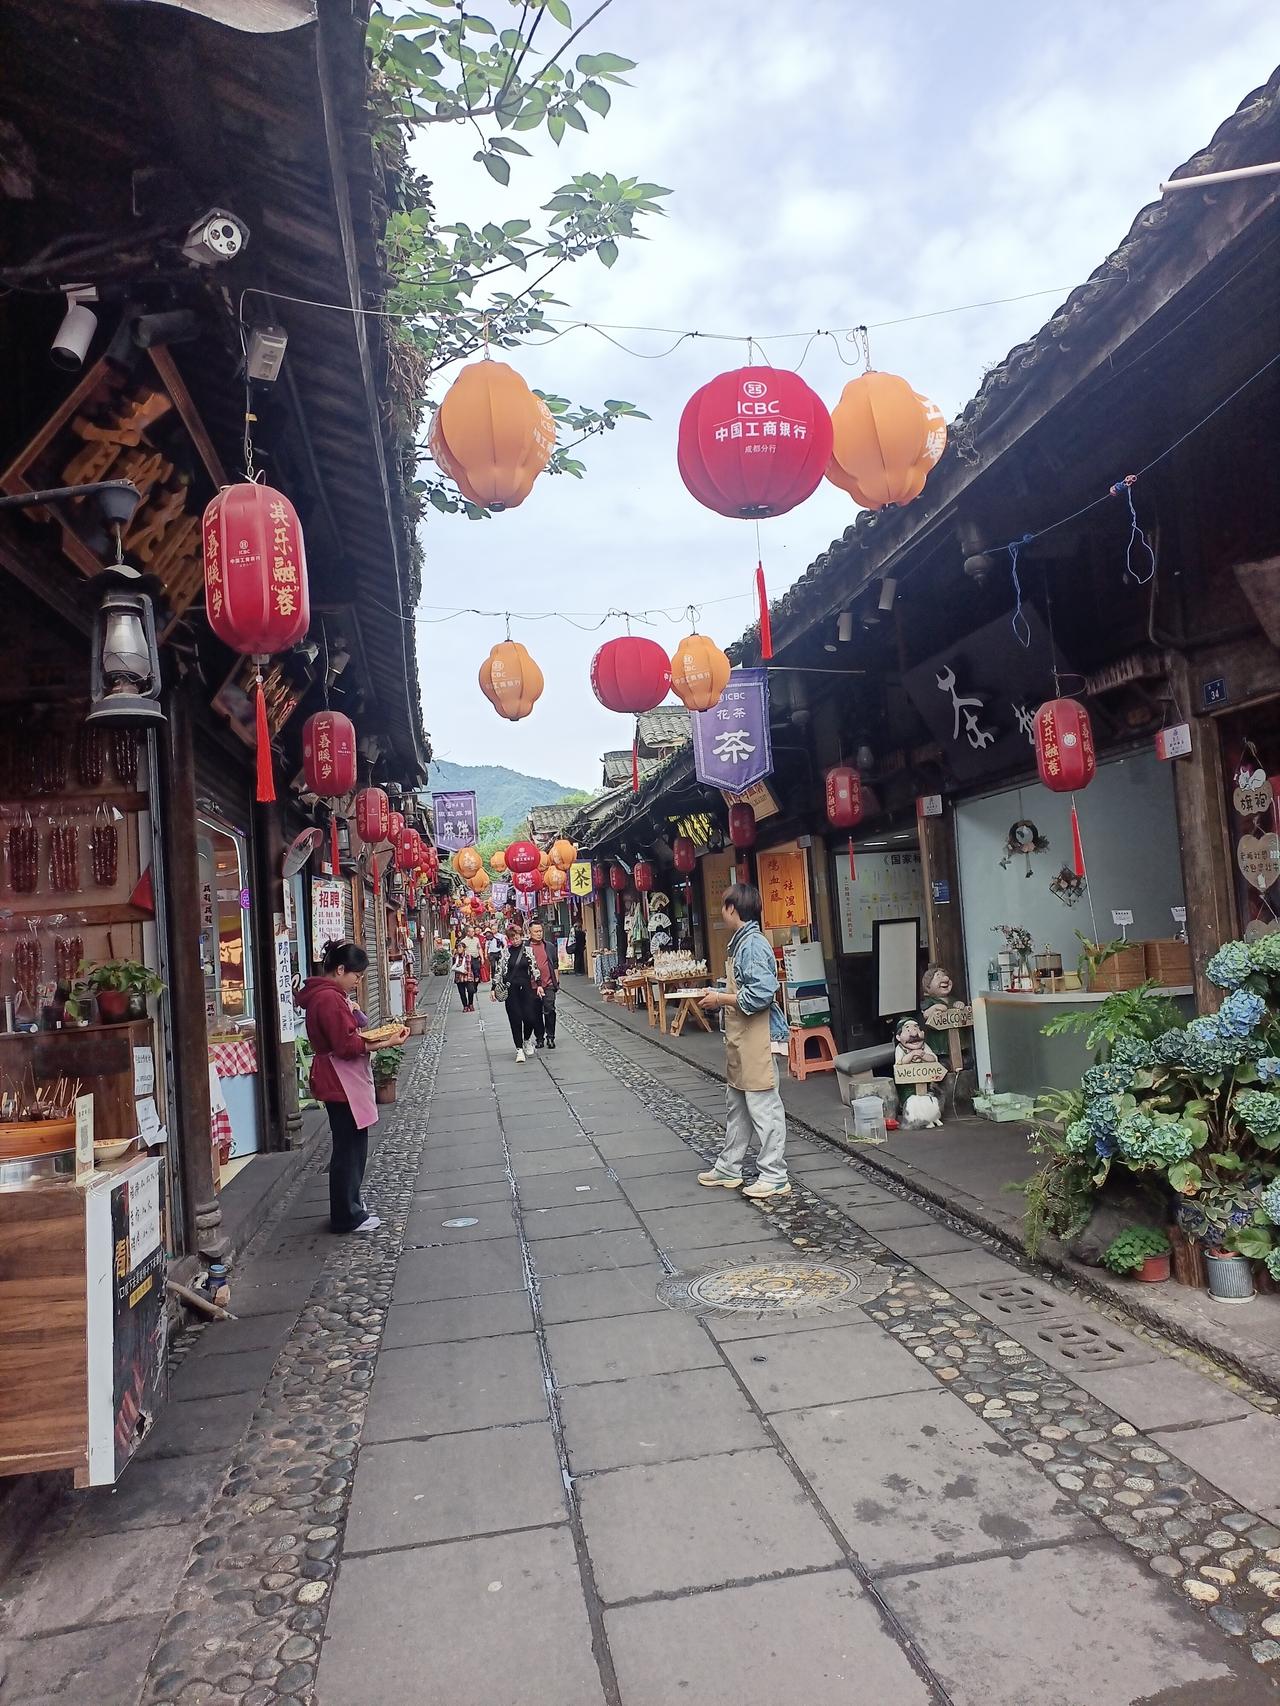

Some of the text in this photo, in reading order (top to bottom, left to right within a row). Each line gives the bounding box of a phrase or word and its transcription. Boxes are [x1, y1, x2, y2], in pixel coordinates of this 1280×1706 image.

[737, 400, 780, 415] ICBC
[715, 421, 807, 442] 中国工商银行
[744, 444, 777, 454] 成都分行
[725, 692, 746, 701] ICBC
[1210, 689, 1220, 700] 34
[716, 707, 746, 720] 花茶
[712, 729, 756, 764] 茶
[1240, 791, 1268, 811] 旗袍
[573, 867, 590, 889] 茶
[319, 890, 340, 909] 招聘
[897, 1067, 943, 1078] Welcome
